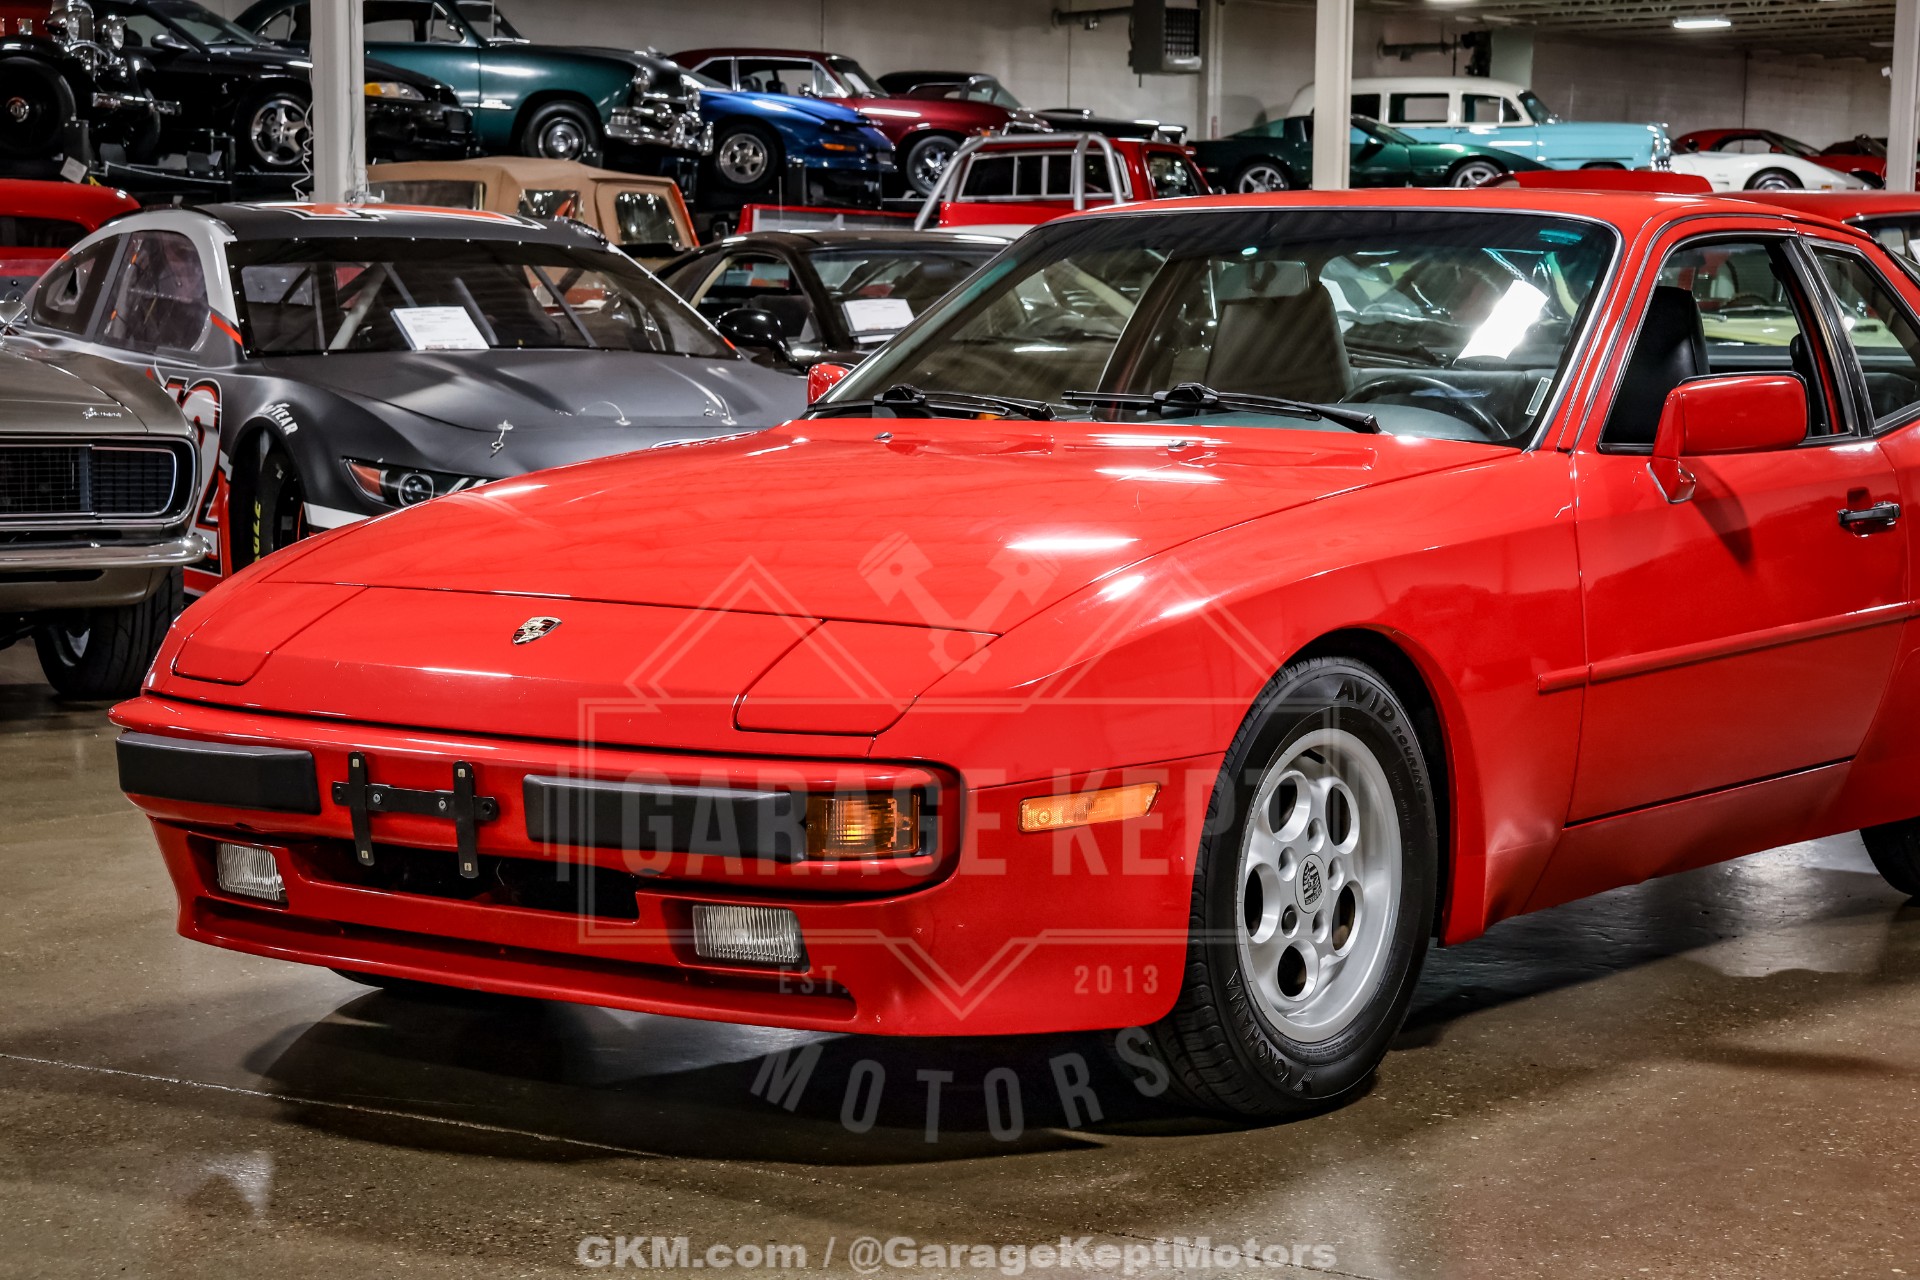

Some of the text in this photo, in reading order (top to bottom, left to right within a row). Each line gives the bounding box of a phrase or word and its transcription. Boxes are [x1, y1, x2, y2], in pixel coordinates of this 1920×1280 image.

[1333, 679, 1396, 723] AVID
[1391, 724, 1428, 804] TOURING
[1225, 967, 1292, 1088] YOKOHAMA
